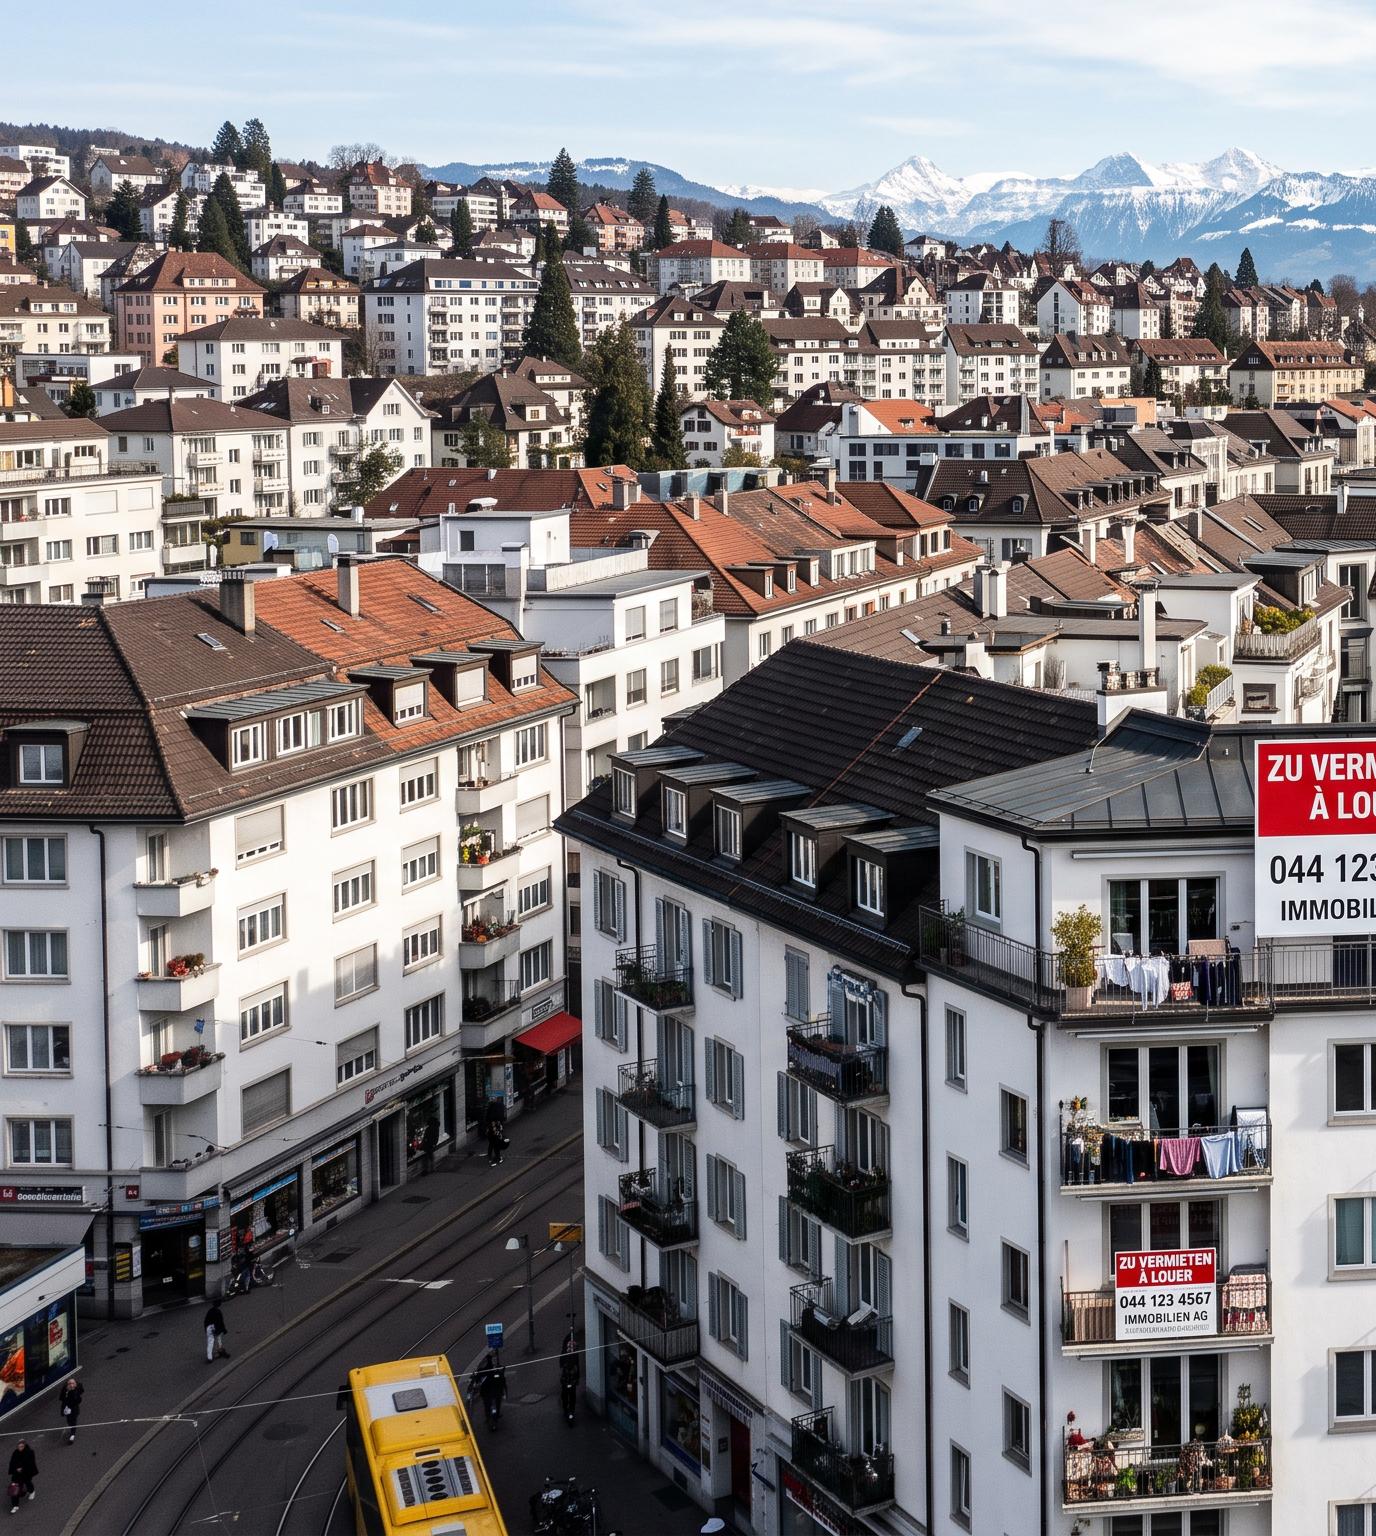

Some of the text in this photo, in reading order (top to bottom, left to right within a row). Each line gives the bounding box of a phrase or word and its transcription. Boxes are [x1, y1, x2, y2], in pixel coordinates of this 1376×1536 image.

[1267, 755, 1302, 781] ZU
[1309, 785, 1329, 820] À
[1270, 855, 1324, 884] 044
[1120, 1253, 1211, 1269] ZU VERMIETEN
[1151, 1269, 1192, 1283] LOUER
[1120, 1292, 1211, 1308] 044 123 4567
[1125, 1311, 1207, 1324] IMMOBILIEN AG
